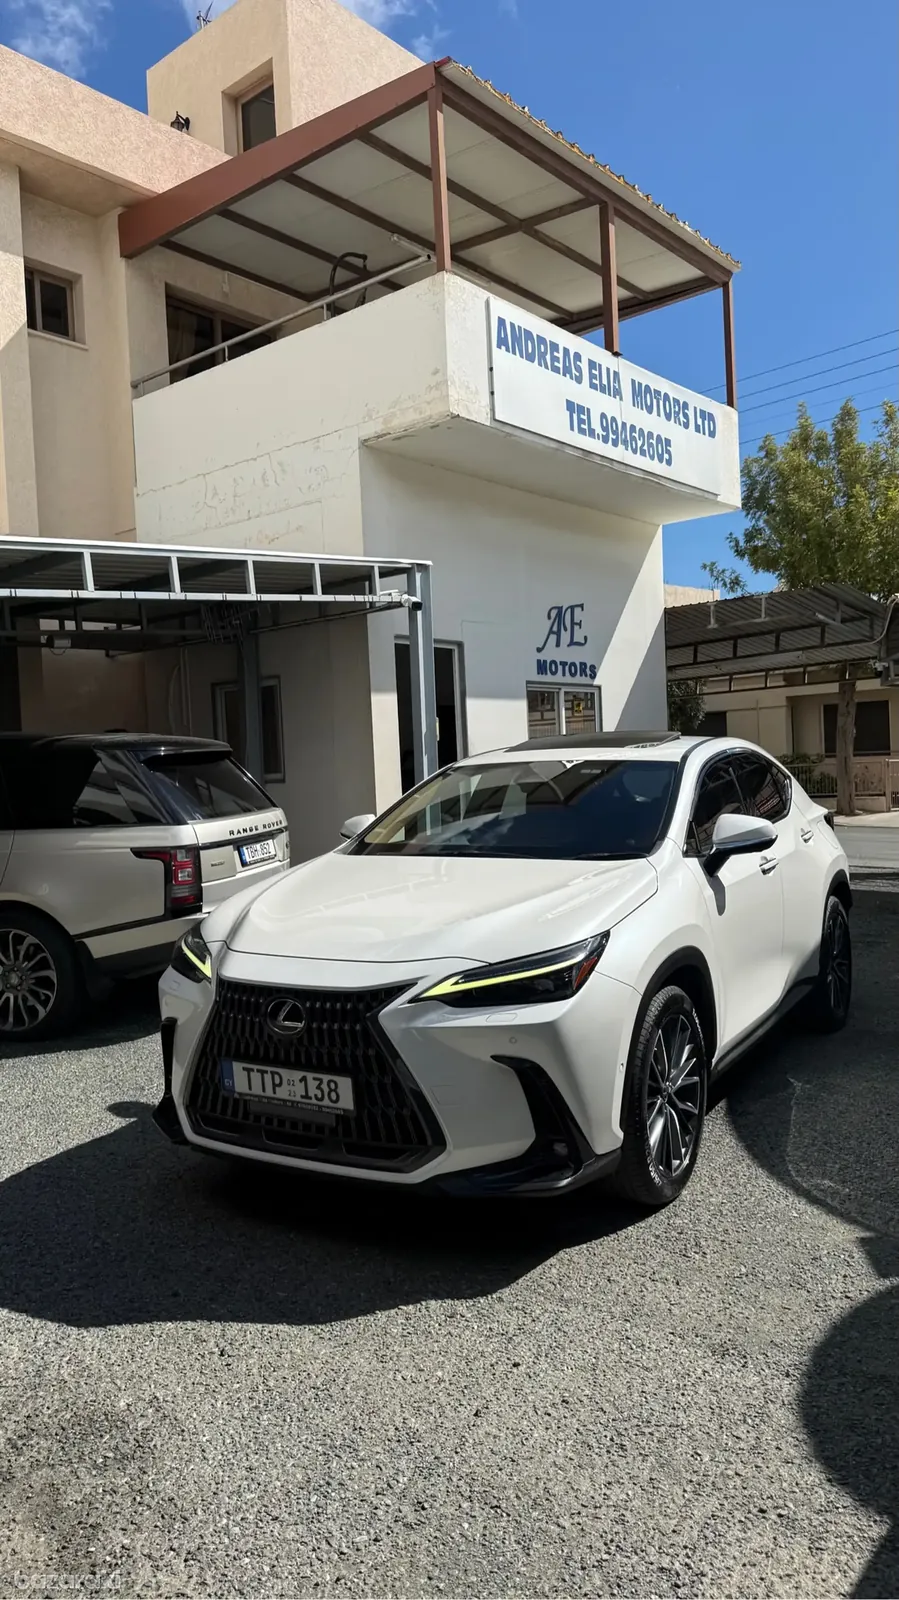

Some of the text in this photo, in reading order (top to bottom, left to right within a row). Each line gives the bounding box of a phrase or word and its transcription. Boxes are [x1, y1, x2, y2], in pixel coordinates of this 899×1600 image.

[496, 316, 717, 439] ANDREAS ELIA MOTORS LTD
[536, 603, 588, 653] AE
[536, 659, 597, 679] MOTORS
[228, 820, 283, 837] RANGE ROVER
[242, 1066, 283, 1095] TTP
[299, 1075, 340, 1104] 138
